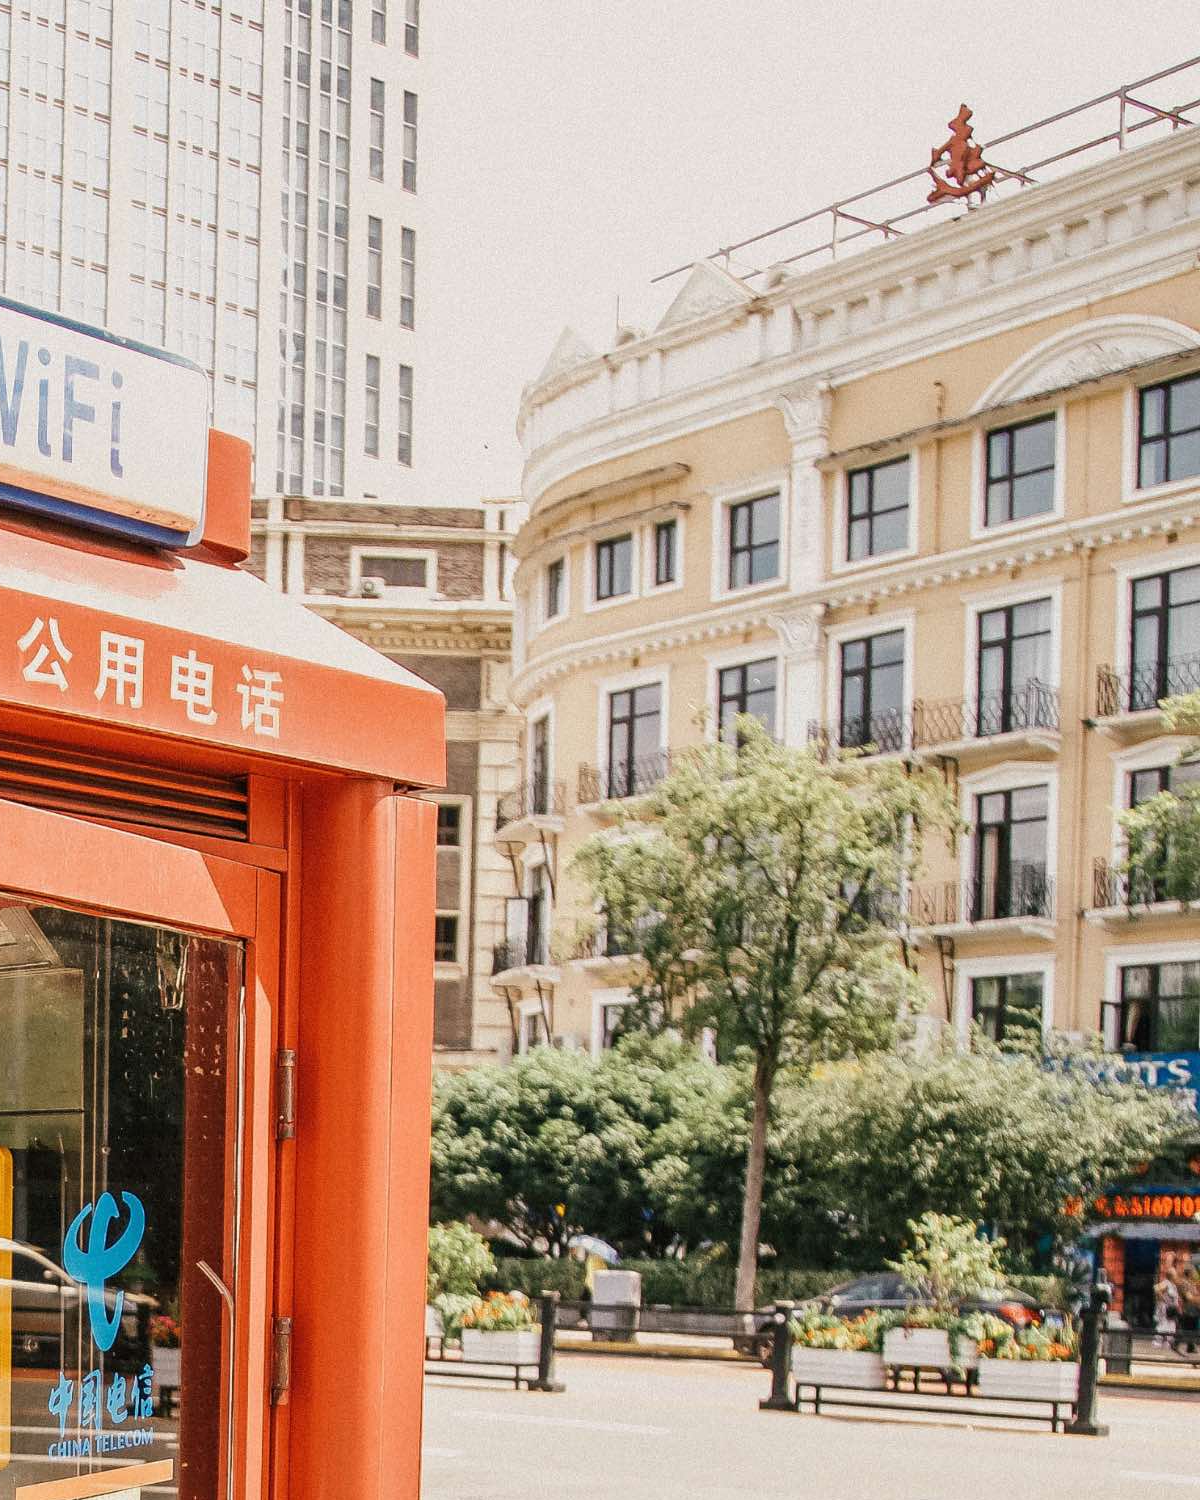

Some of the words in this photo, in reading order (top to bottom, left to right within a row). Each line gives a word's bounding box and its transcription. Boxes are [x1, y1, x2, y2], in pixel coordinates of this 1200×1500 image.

[16, 616, 285, 739] 公用电话
[48, 1363, 154, 1438] 中国电信
[48, 1437, 90, 1459] CHINA
[95, 1427, 154, 1453] TELECOM
